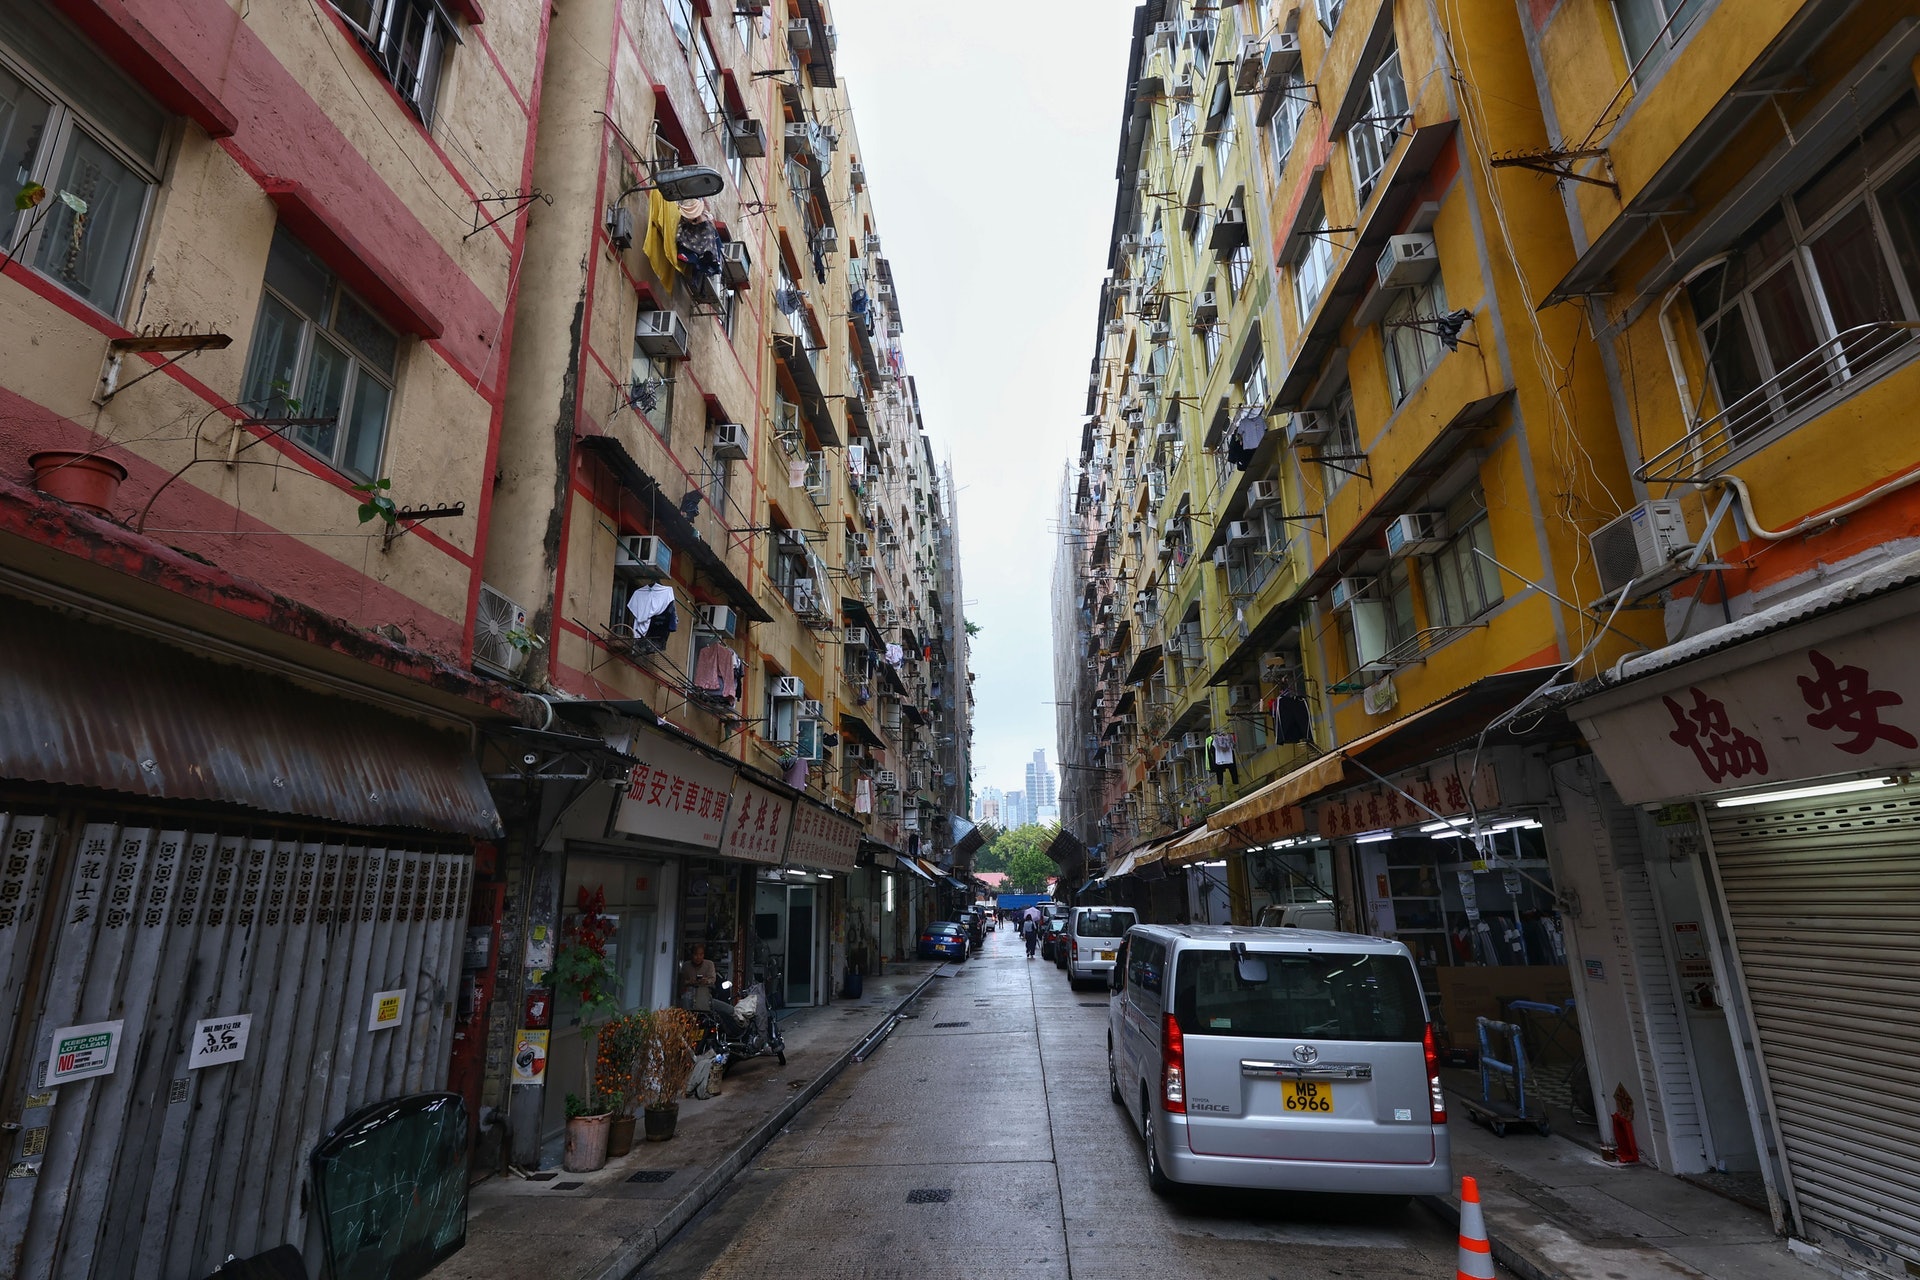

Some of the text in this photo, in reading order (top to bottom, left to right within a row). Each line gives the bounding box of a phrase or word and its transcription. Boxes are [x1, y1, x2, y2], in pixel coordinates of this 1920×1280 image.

[1662, 650, 1918, 783] 協安
[627, 763, 728, 822] 協安汽車玻璃
[61, 1040, 108, 1053] LOT CLEAN
[64, 1034, 107, 1047] KEEP OUR
[58, 1053, 75, 1072] NO
[1295, 1081, 1317, 1096] MB
[1191, 1103, 1230, 1112] HIACE
[1286, 1096, 1330, 1111] 6966
